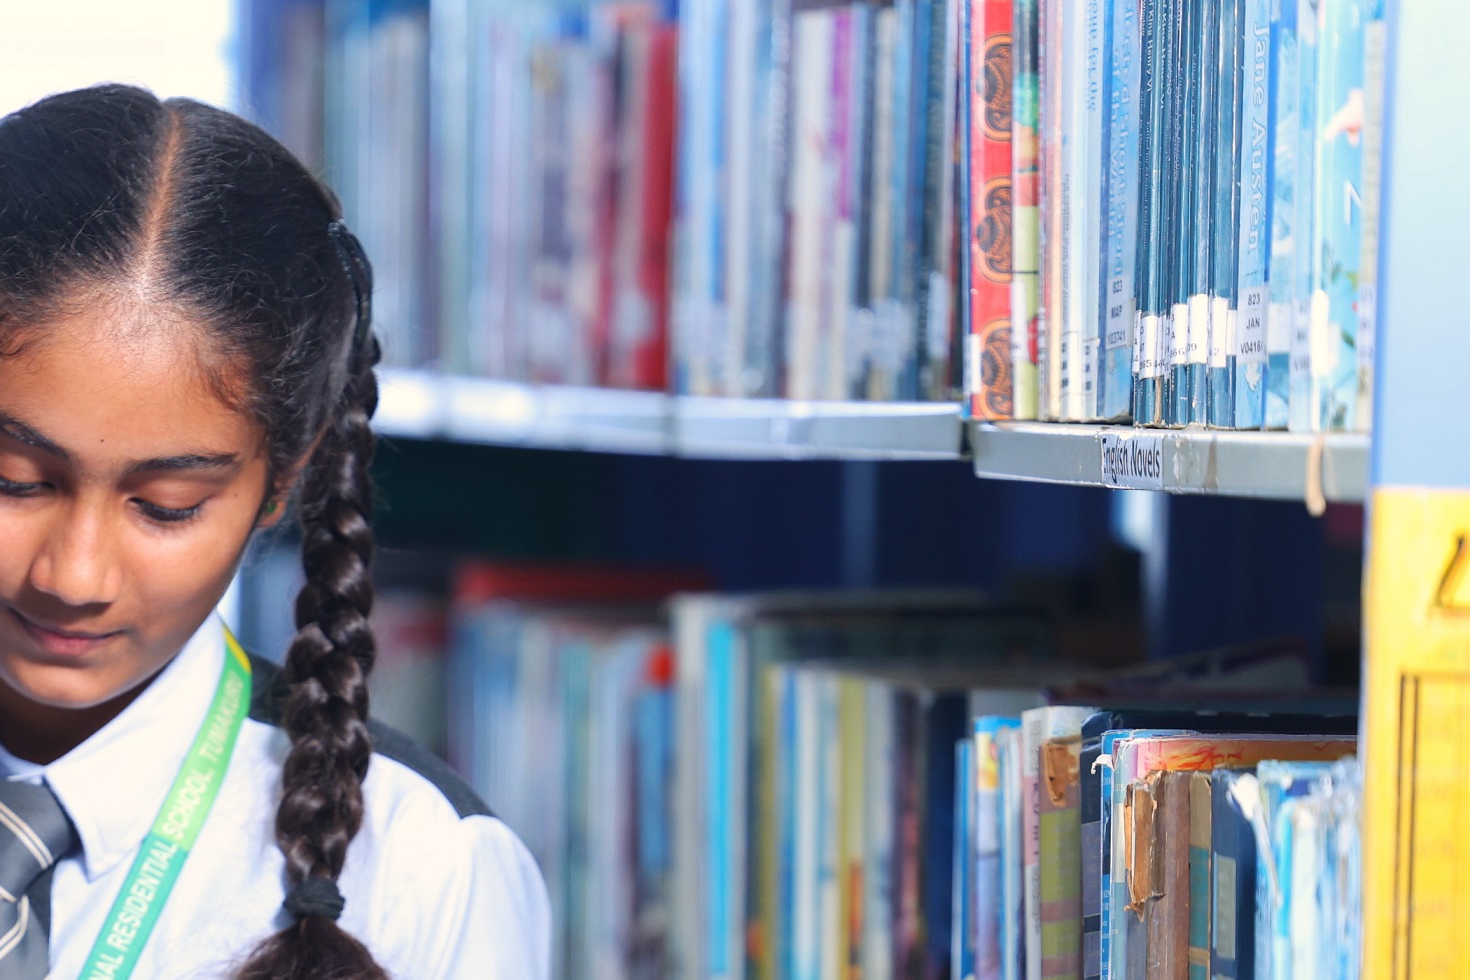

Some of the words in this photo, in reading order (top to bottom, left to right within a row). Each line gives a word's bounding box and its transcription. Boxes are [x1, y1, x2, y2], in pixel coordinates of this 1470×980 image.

[1252, 23, 1269, 108] Jane
[1249, 118, 1268, 256] Austen
[1246, 317, 1260, 330] JAN
[1247, 294, 1261, 306] 823
[1130, 438, 1161, 479] Novels
[107, 839, 178, 953] RESIDENTIAL
[198, 669, 246, 765] TUMAKURU
